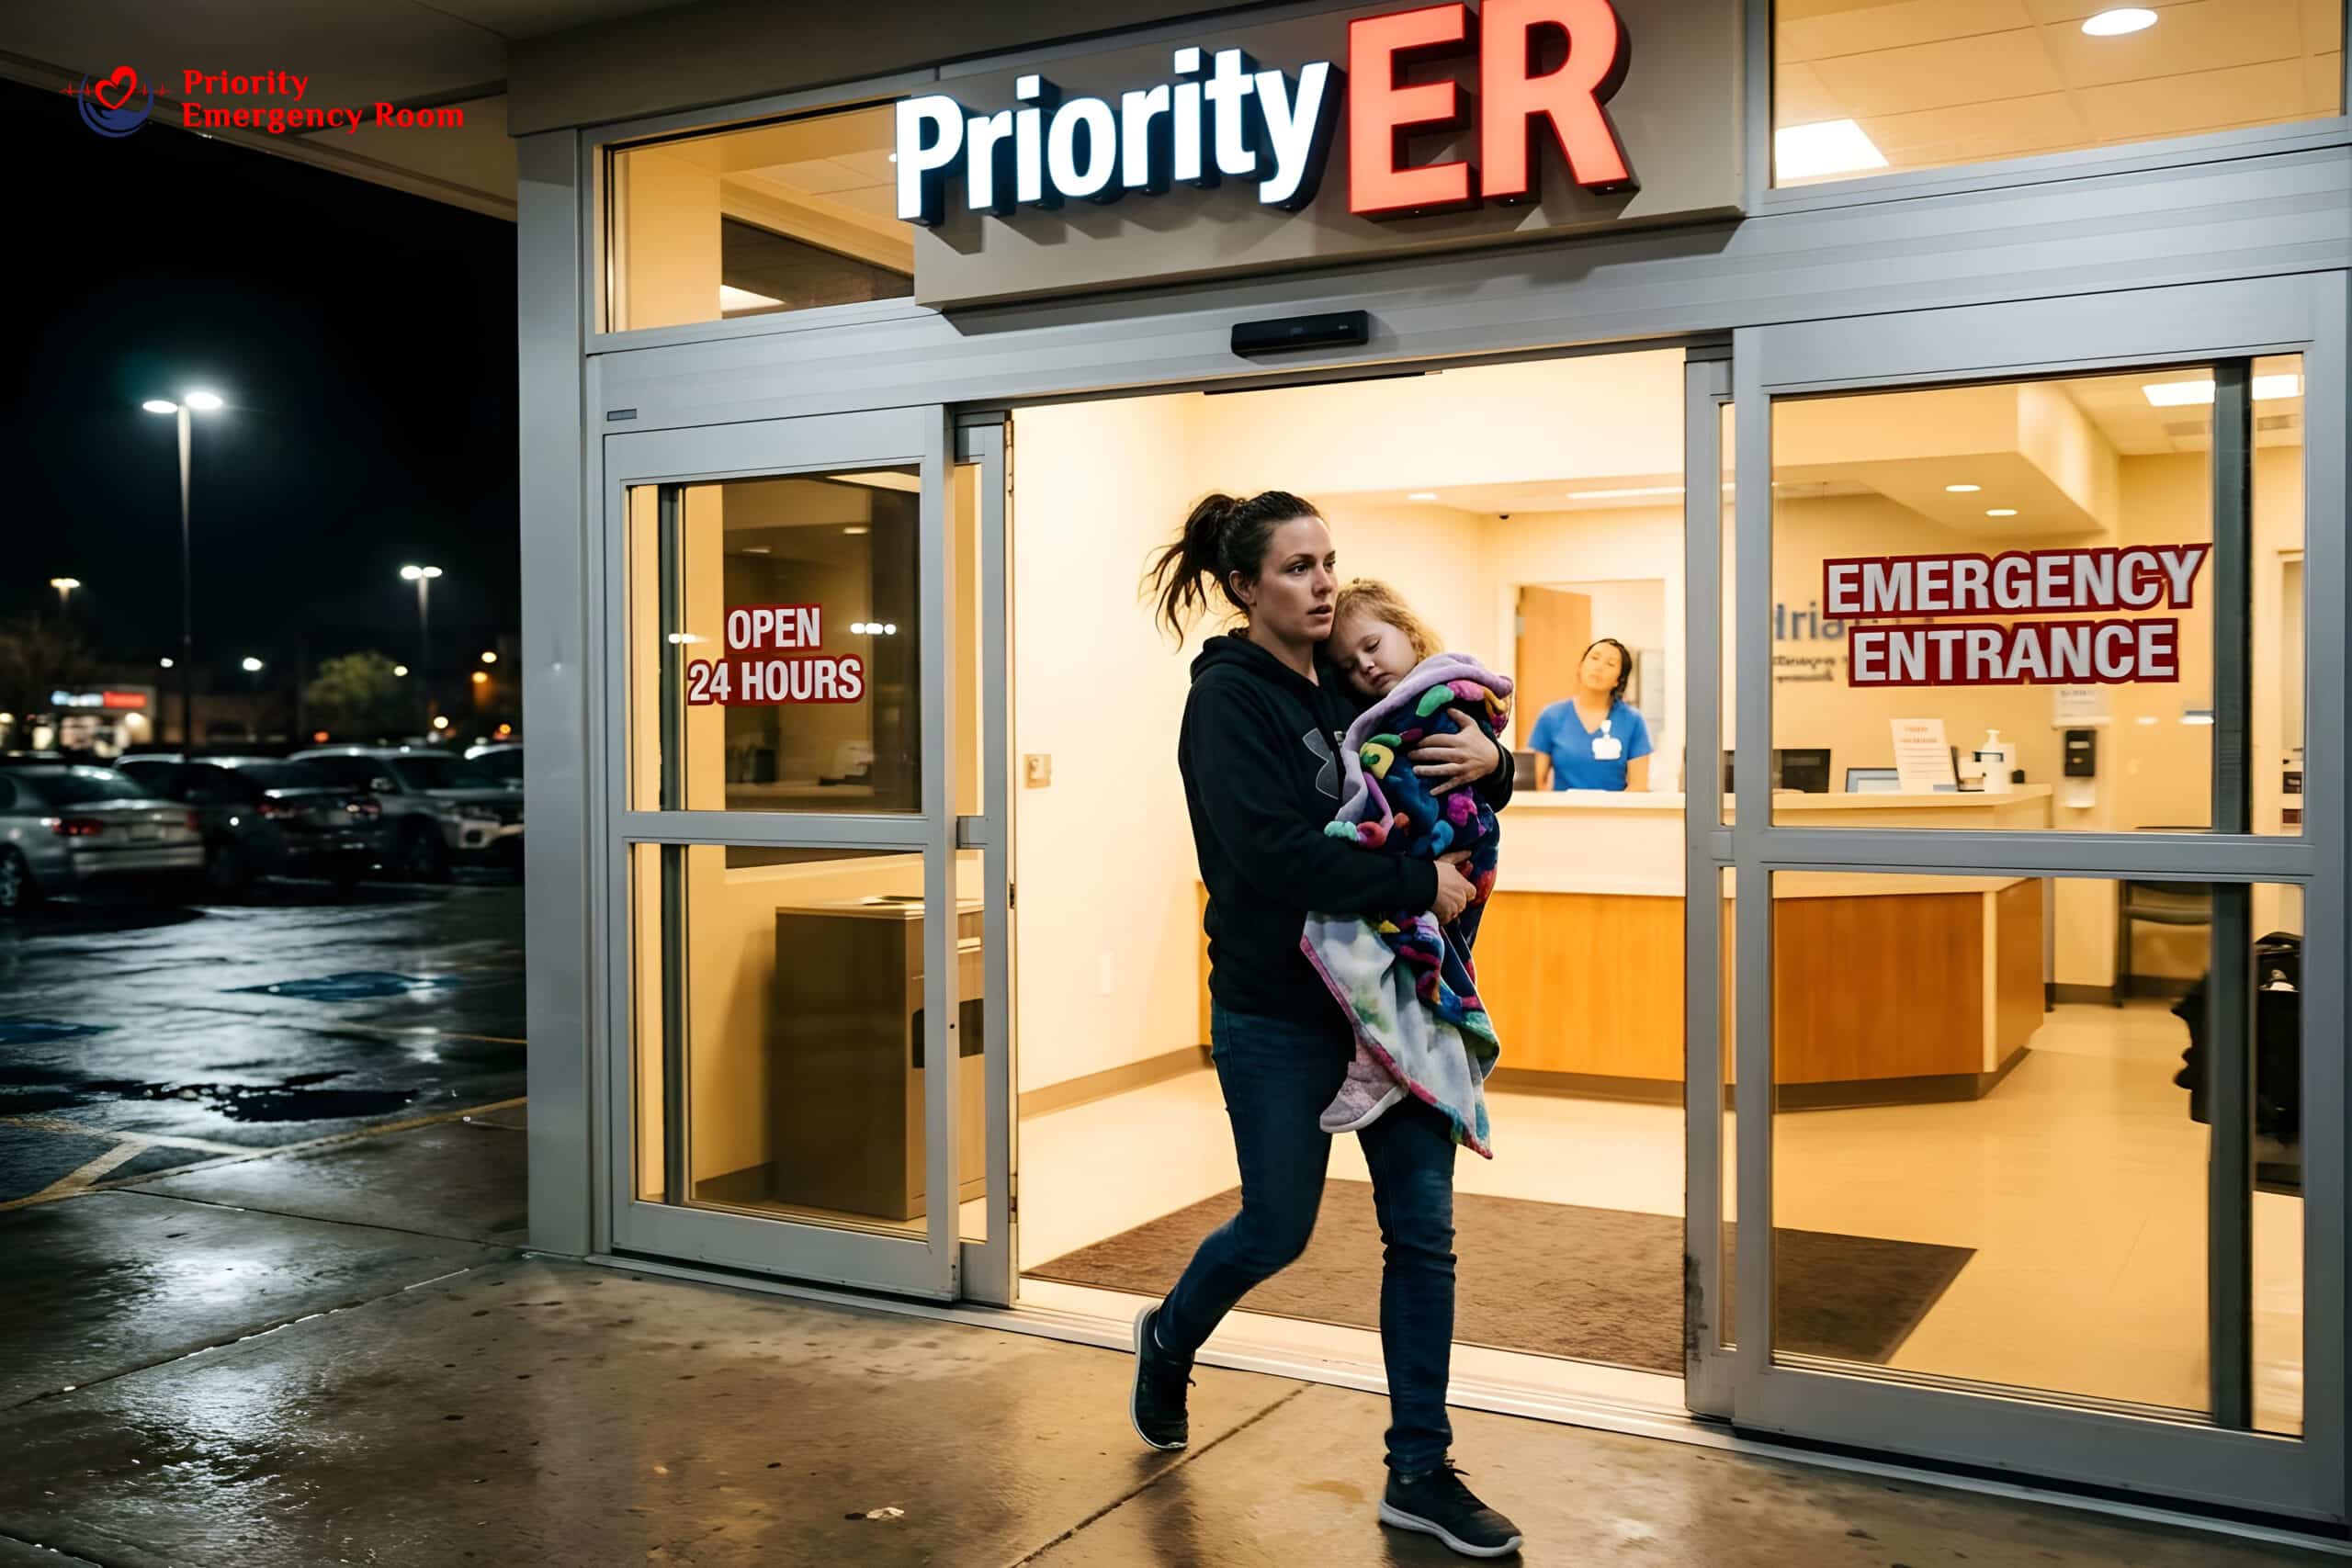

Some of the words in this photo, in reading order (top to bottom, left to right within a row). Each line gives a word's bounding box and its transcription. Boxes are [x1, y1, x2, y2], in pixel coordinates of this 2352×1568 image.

[1827, 550, 2203, 614] EMERGENCY
[728, 608, 820, 650] OPEN
[1853, 625, 2175, 682] ENTRANCE
[687, 663, 731, 702] 24
[741, 659, 863, 701] HOURS
